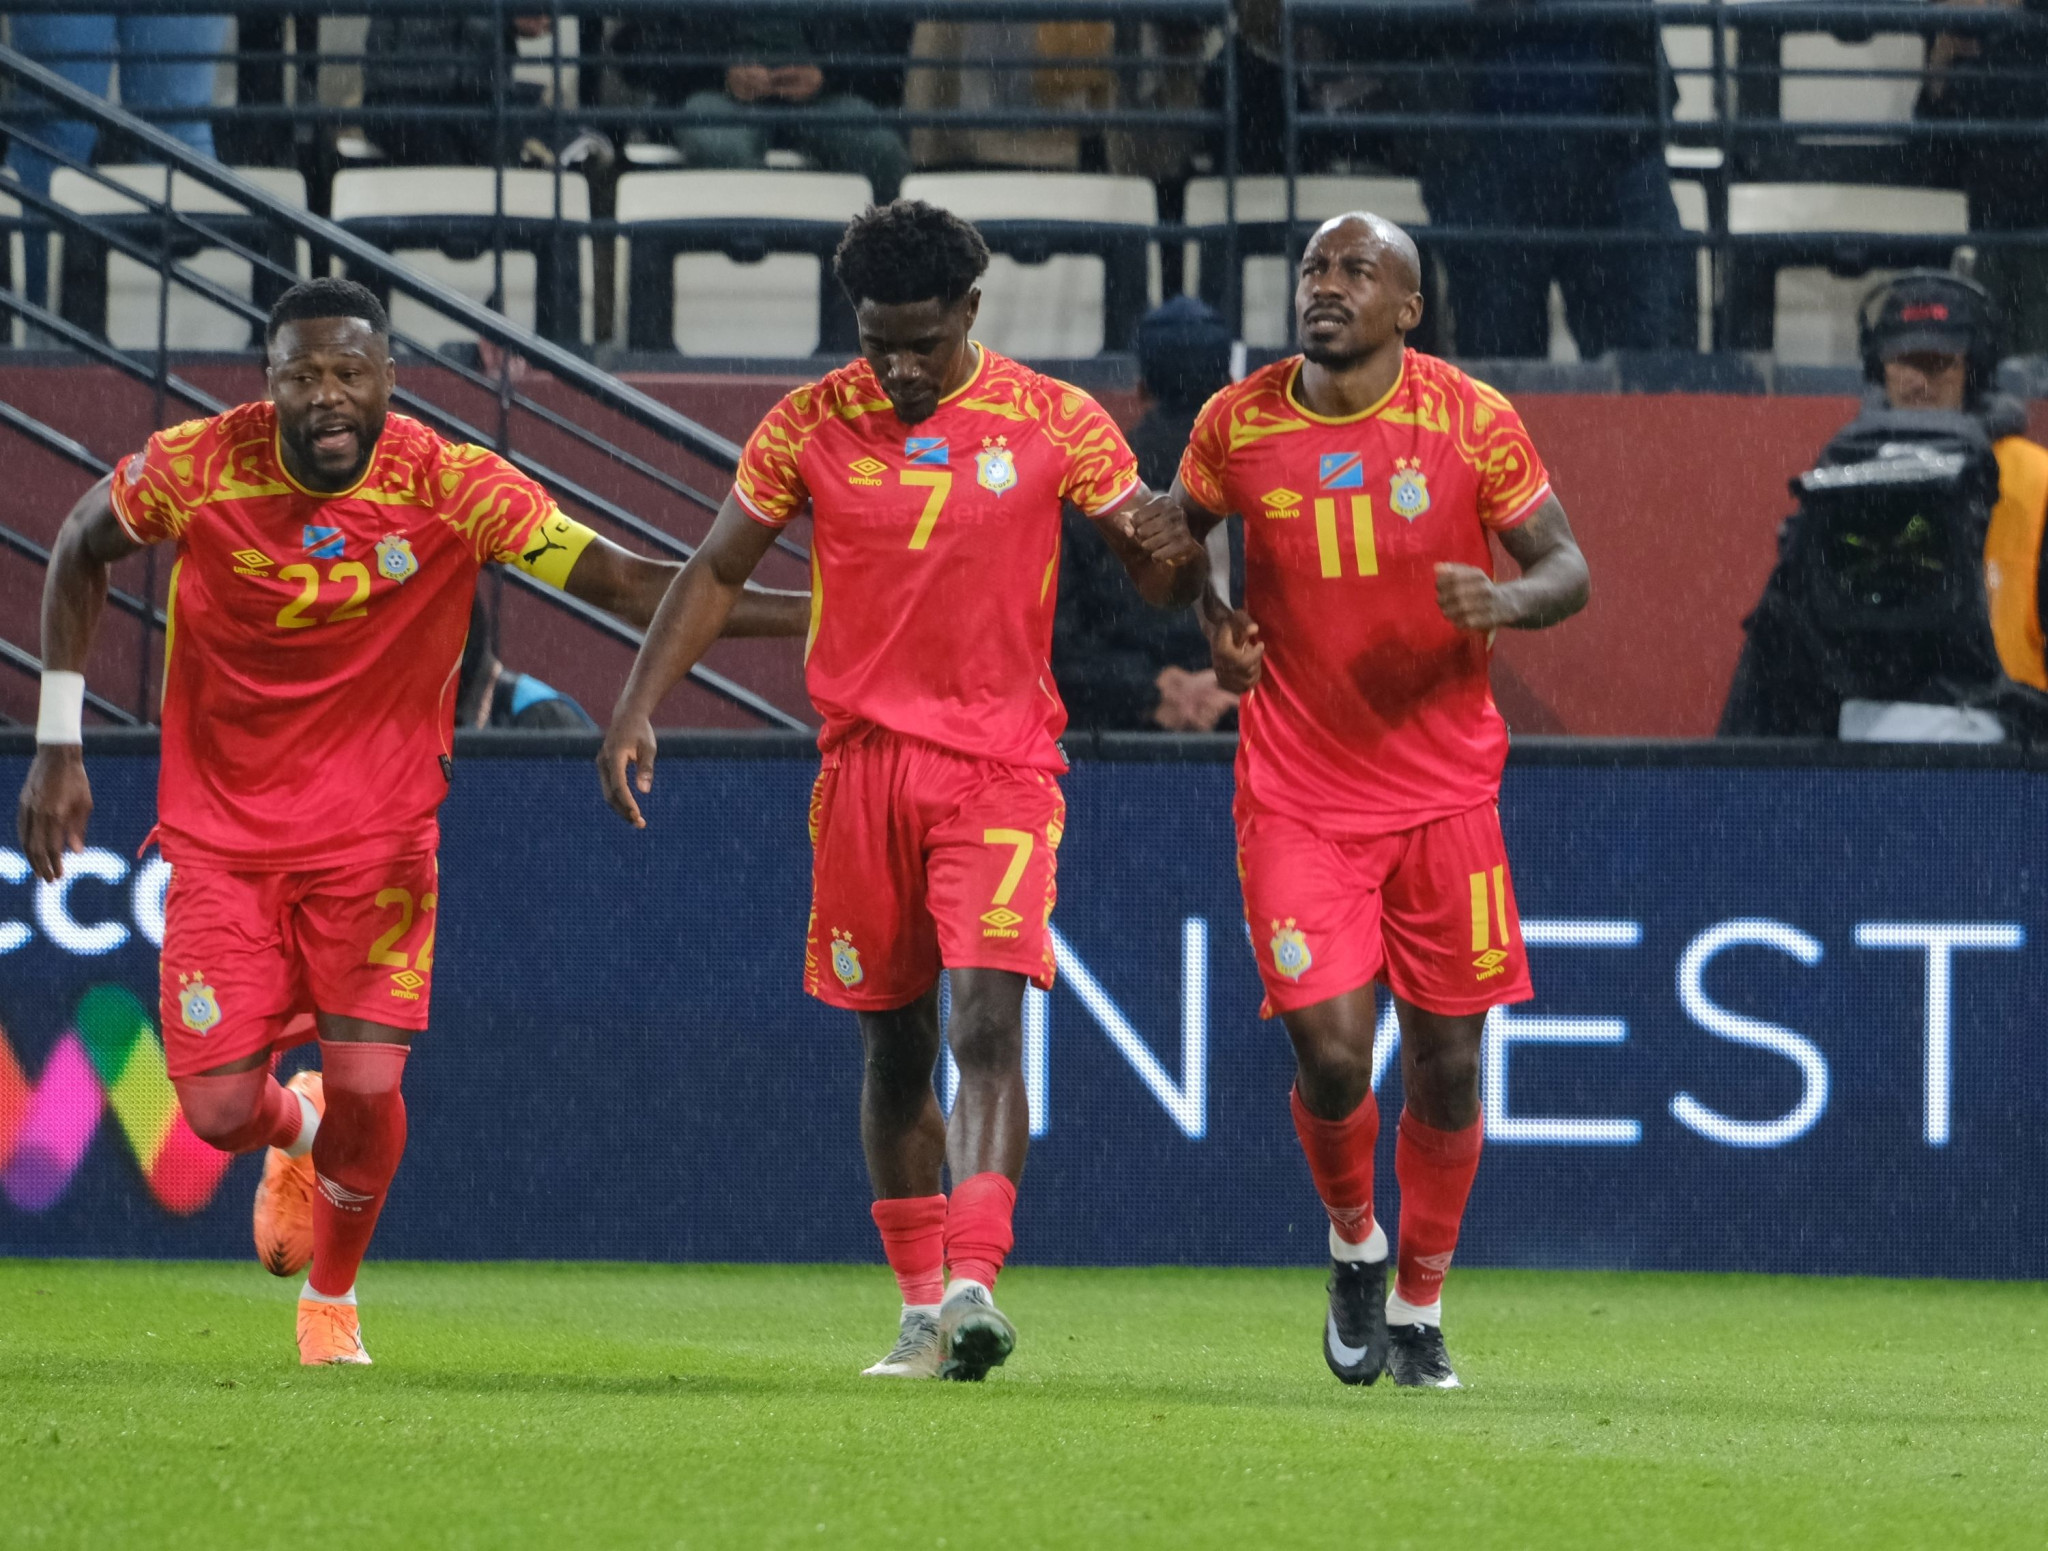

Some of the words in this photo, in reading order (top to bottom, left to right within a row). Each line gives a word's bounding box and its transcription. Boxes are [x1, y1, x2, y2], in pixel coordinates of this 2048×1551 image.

[849, 476, 883, 486] umbro
[900, 469, 952, 550] 7
[1265, 508, 1300, 519] umbro
[1314, 494, 1379, 578] 11
[233, 565, 269, 577] umbro
[276, 561, 371, 628] 22
[983, 828, 1033, 905] 7
[1469, 864, 1510, 952] 11
[983, 927, 1019, 938] umbro
[391, 988, 420, 1000] umbro
